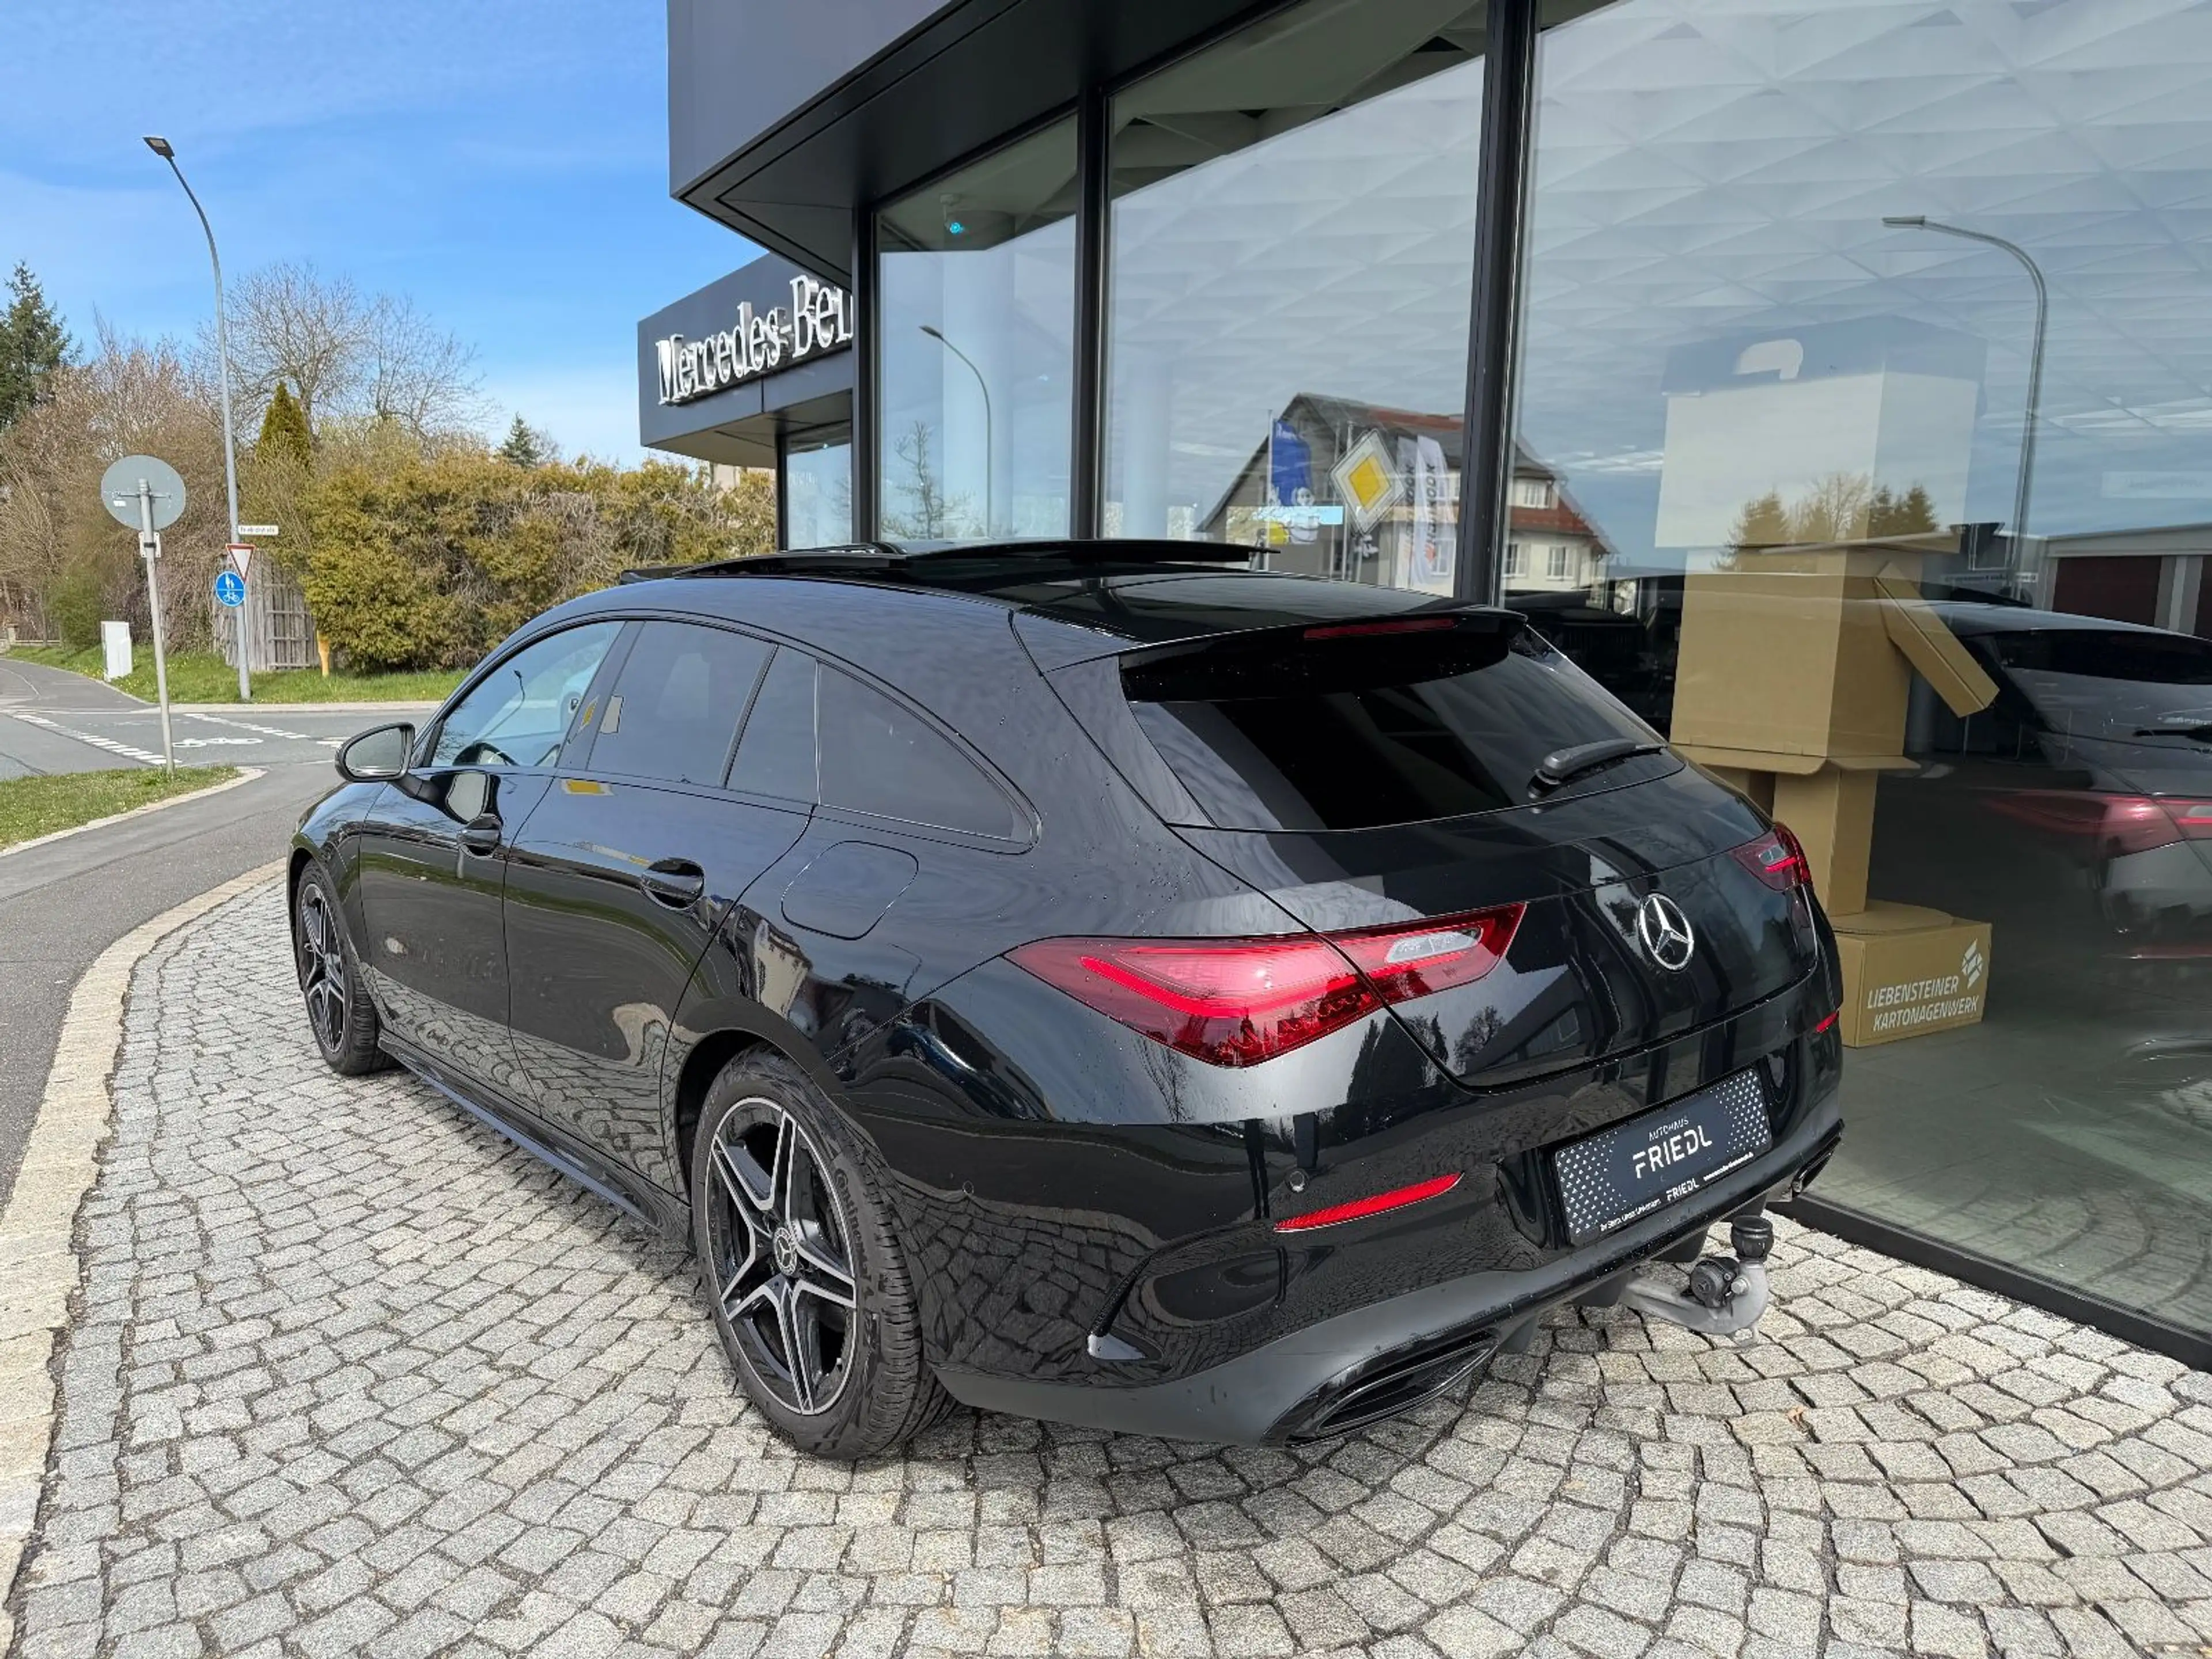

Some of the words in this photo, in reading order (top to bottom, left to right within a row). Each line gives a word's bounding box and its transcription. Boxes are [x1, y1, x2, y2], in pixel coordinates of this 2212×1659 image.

[1867, 975, 1959, 1009] LIEBENSTEINER
[1873, 995, 1979, 1032] KARTONAGENWERK
[1649, 1118, 1689, 1141] AUTOHAUS
[1633, 1125, 1713, 1179] FRIEDL
[1666, 1177, 1699, 1201] FRIEDL
